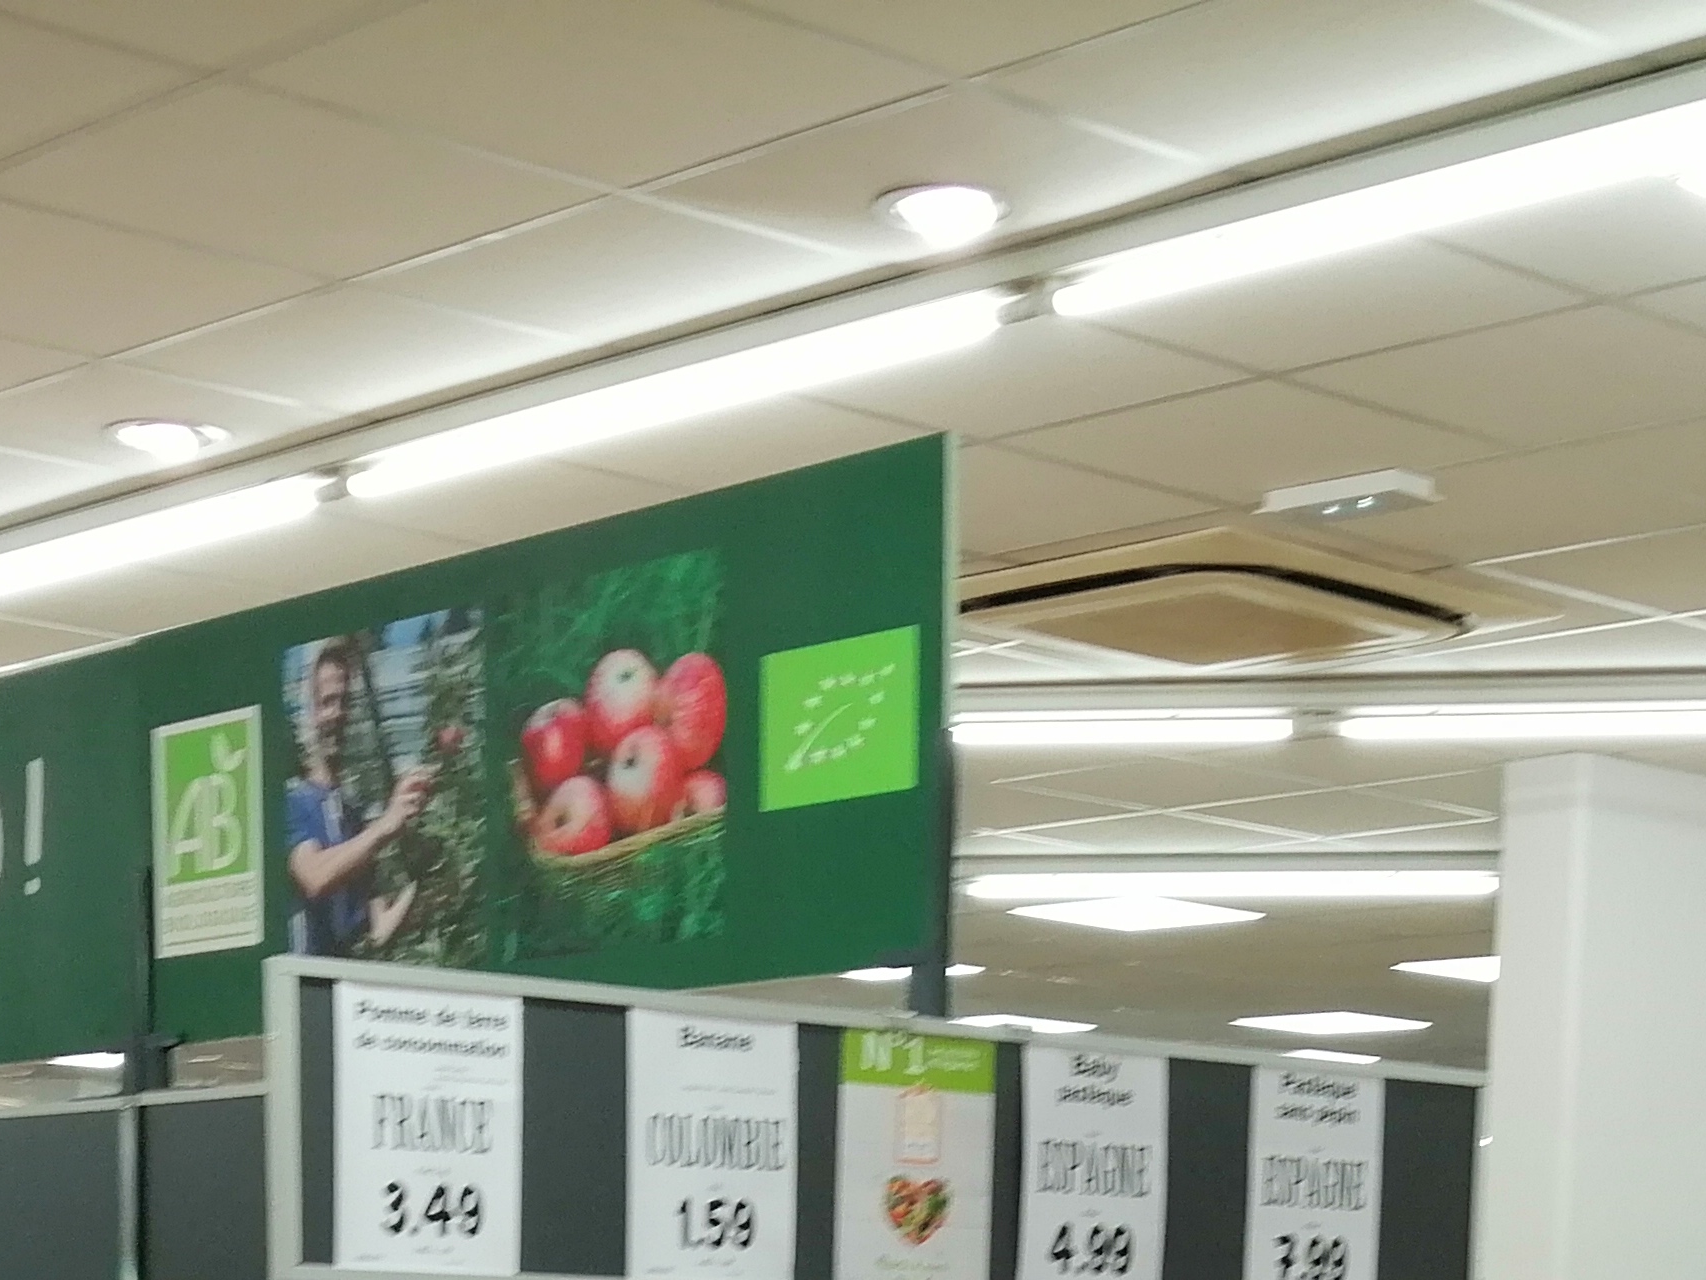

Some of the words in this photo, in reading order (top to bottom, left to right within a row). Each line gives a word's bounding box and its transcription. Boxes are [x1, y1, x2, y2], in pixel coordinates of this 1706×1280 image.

[371, 1093, 492, 1154] FRANCE
[646, 1114, 785, 1171] COLOMBIE
[1037, 1139, 1151, 1197] ESPAGNE
[1260, 1155, 1368, 1210] ESPAGNE
[380, 1181, 480, 1237] 3.49
[676, 1197, 756, 1250] 1.59
[1046, 1223, 1134, 1277] 4.99
